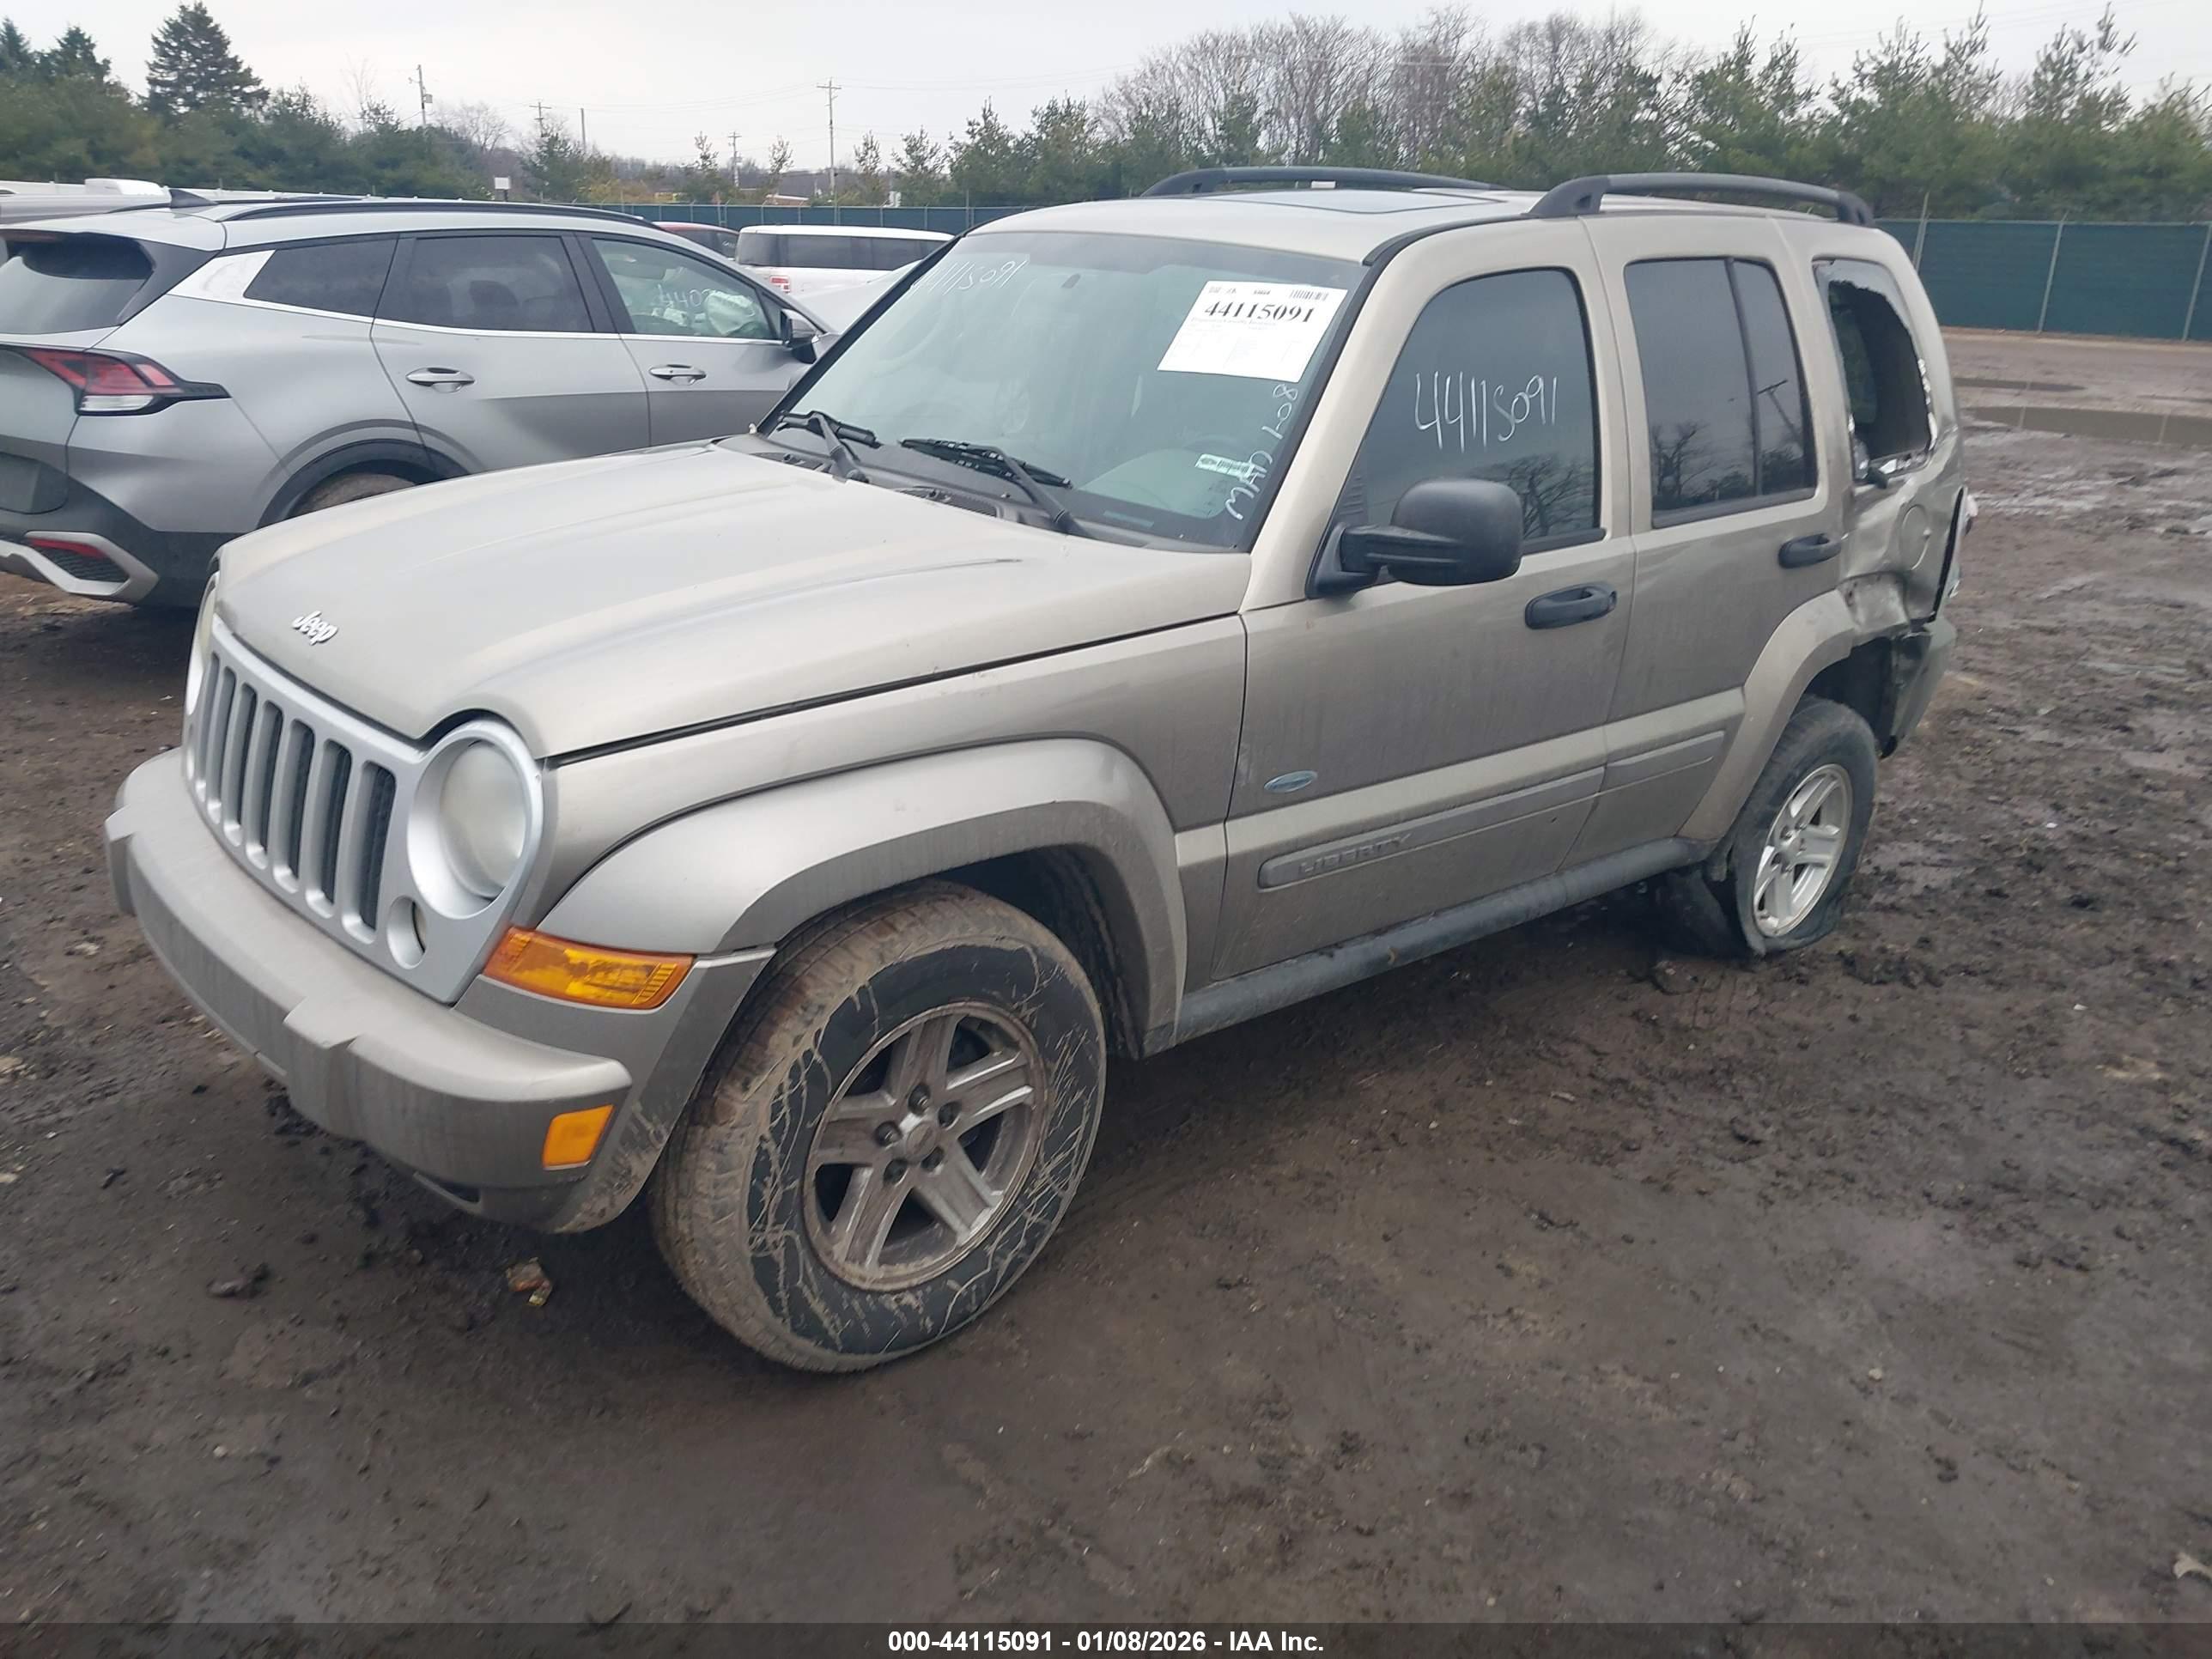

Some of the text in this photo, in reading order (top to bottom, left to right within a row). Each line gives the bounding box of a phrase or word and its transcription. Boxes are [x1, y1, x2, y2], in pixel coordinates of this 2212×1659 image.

[1205, 301, 1316, 323] 44115091
[1414, 370, 1559, 453] 44115091
[292, 610, 339, 646] Jeep
[1298, 832, 1413, 874] LIBERTY
